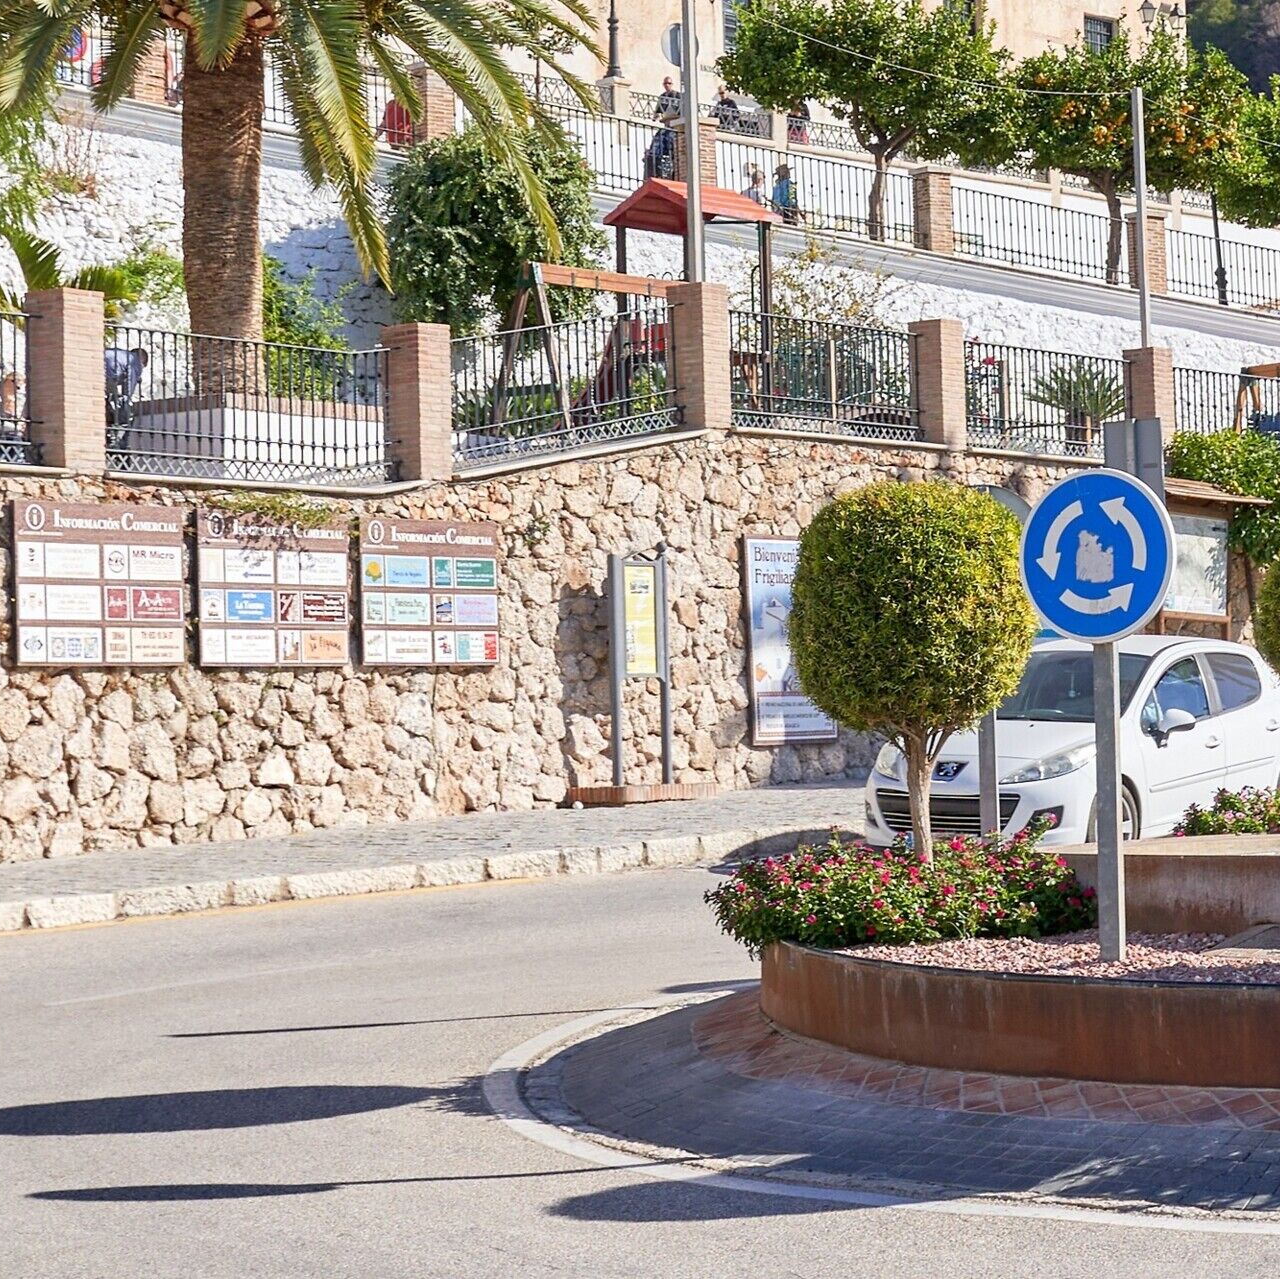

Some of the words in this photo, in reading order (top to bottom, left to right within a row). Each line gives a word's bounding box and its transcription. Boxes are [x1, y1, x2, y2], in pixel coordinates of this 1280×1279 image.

[53, 509, 120, 530] INFORMACIÓN
[121, 512, 179, 533] COMERCIAL
[754, 547, 797, 562] Bienveni
[755, 568, 796, 586] Frigilian
